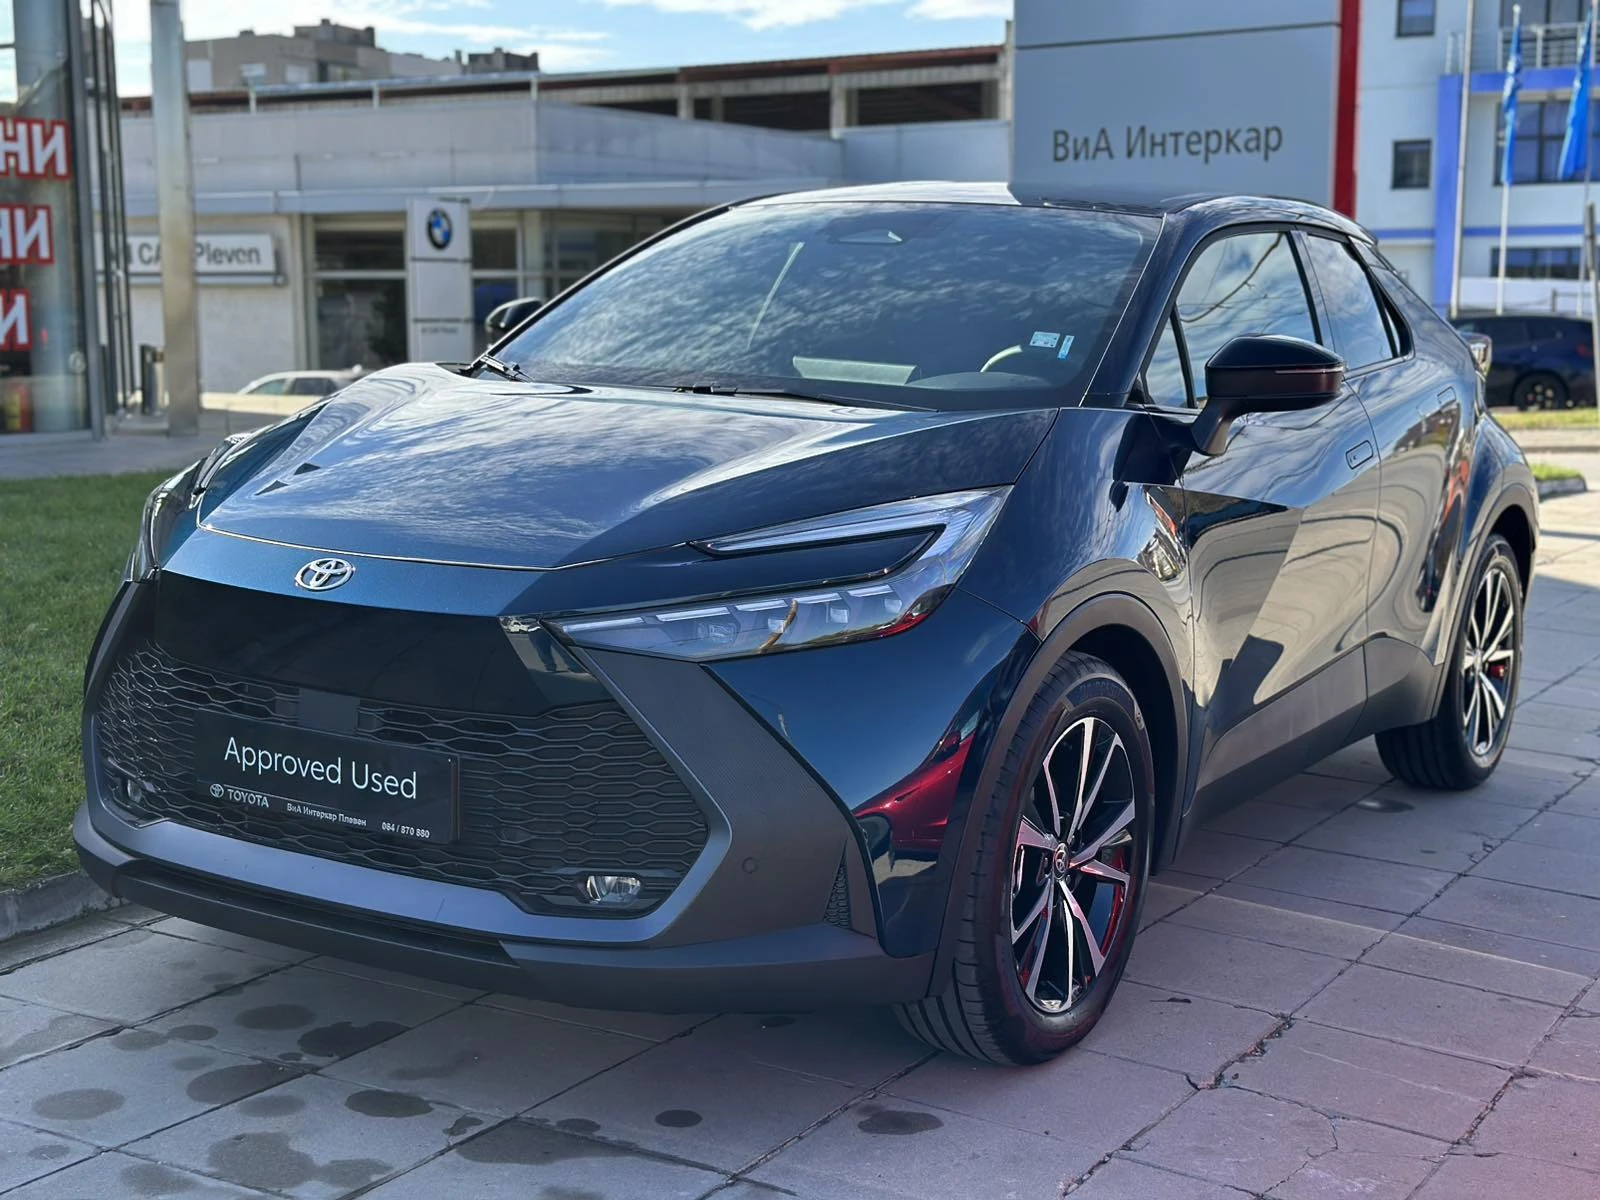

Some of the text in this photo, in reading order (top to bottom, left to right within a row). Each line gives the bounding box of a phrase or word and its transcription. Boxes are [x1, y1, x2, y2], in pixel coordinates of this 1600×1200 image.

[1053, 125, 1283, 165] ВиА Интеркар
[224, 736, 417, 800] Approved Used
[227, 787, 270, 809] TOYOTA
